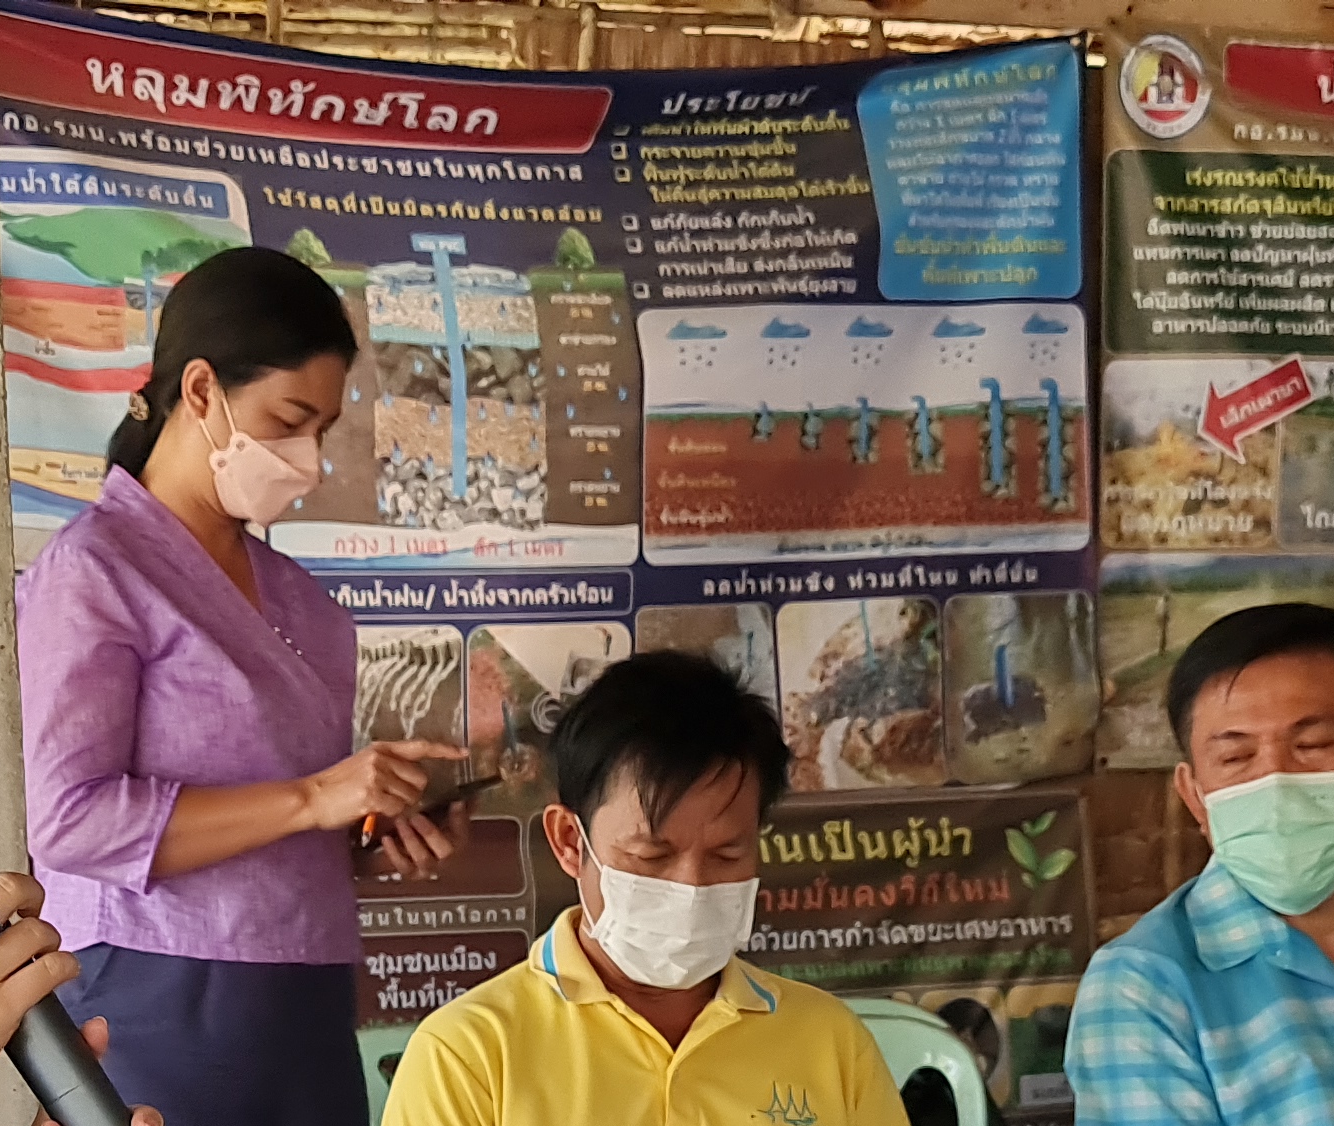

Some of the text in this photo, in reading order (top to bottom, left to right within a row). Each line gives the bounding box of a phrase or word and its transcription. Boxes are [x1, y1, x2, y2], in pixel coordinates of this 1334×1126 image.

[85, 56, 500, 137] หลุมพิทักษ์โลก
[1, 170, 216, 211] มน้ำใต้ดินระดับตื้น
[759, 869, 1011, 913] ามมั่นคงวิถีใหม่
[358, 904, 526, 928] ชนในทุกโอกาส
[743, 913, 1073, 953] ด้วยการกำจัดขยะเศษอาหาร
[366, 945, 497, 981] ชุมชนเมือง
